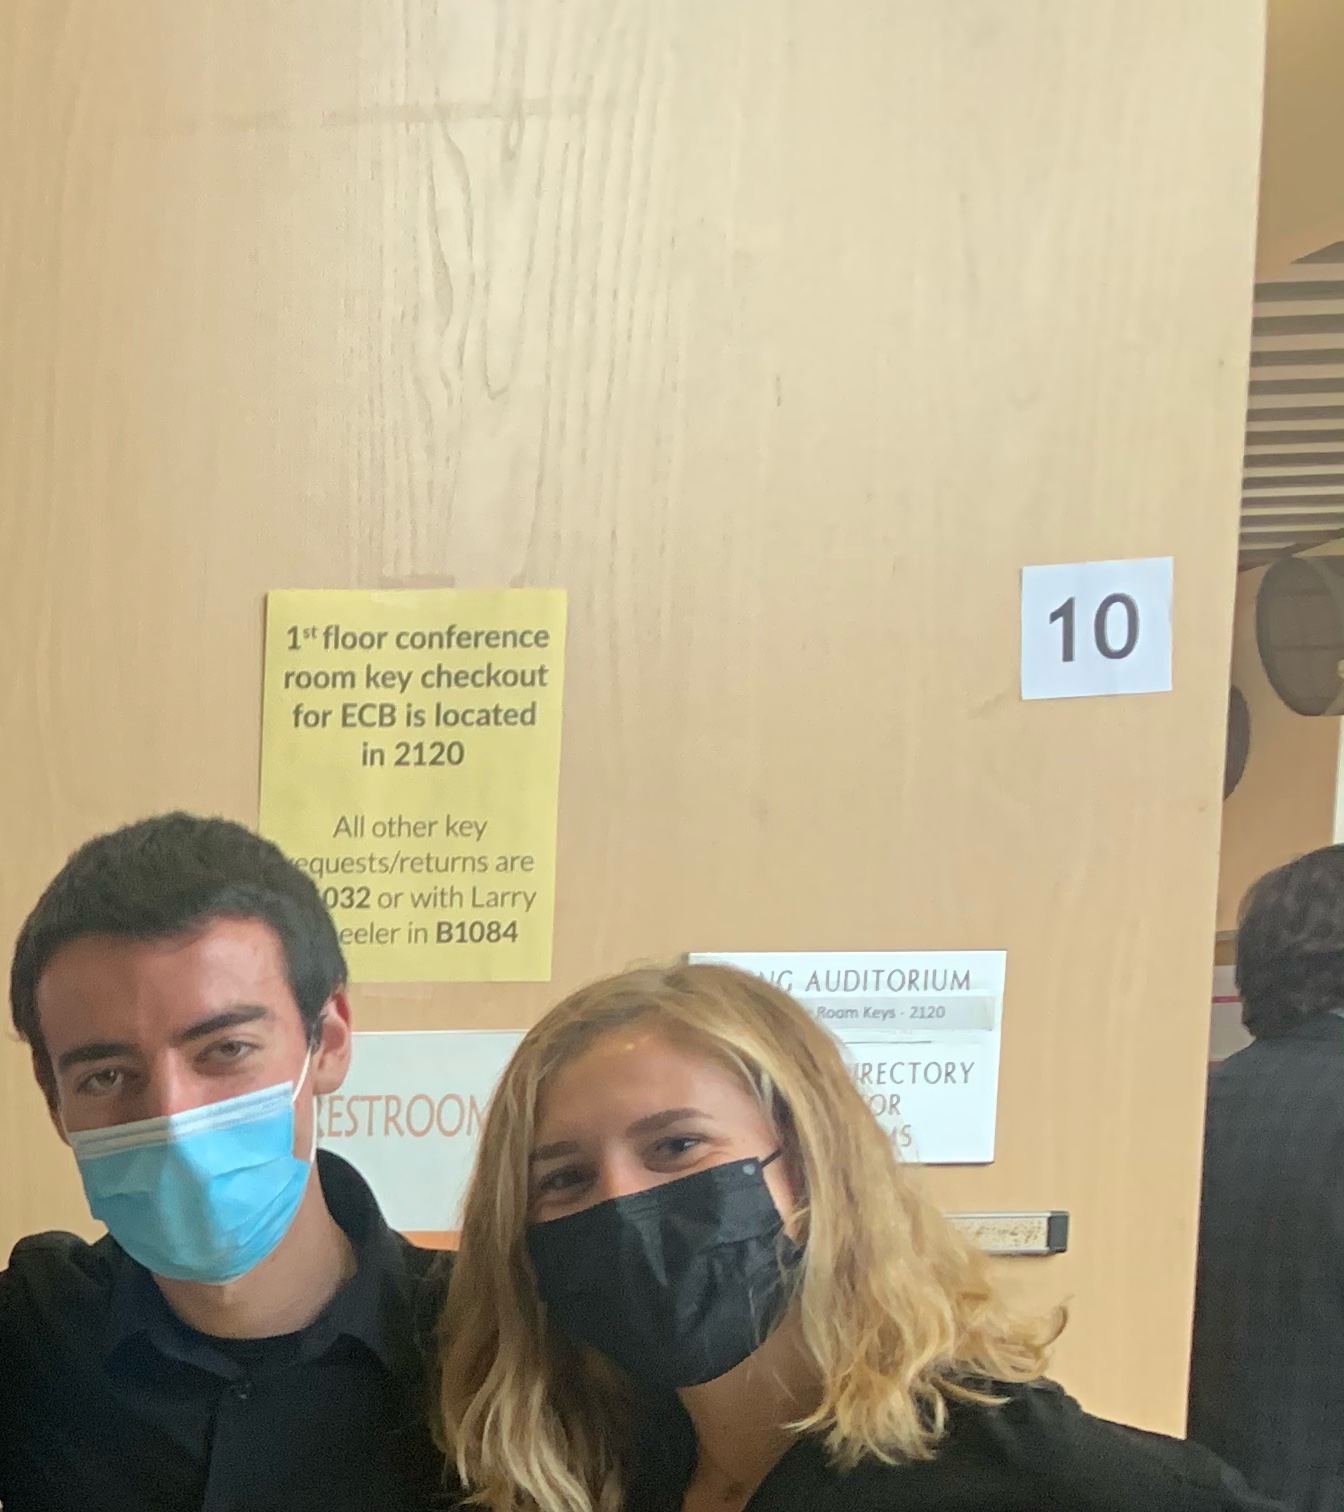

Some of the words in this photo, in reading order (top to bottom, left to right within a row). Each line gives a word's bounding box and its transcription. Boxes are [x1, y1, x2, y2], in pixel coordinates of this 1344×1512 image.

[286, 624, 318, 651] 1st
[322, 624, 388, 651] floor
[395, 623, 551, 650] conference
[1049, 592, 1140, 662] 10
[283, 666, 356, 690] room
[365, 664, 413, 694] key
[420, 662, 549, 689] checkout
[292, 702, 333, 729] for
[341, 703, 397, 729] ECB
[406, 702, 426, 728] is
[435, 701, 537, 728] located
[362, 741, 385, 767] in
[394, 740, 465, 767] 2120
[332, 814, 365, 840] All
[372, 814, 439, 839] other
[445, 814, 489, 842] key
[290, 850, 489, 878] equests/returns
[495, 855, 535, 873] are
[322, 886, 371, 909] 032
[377, 891, 404, 909] or
[410, 885, 462, 909] with
[471, 885, 537, 912] Larry
[339, 921, 402, 945] eeler
[407, 921, 429, 944] in
[436, 920, 520, 944] B1084
[805, 968, 972, 993] AUDITORIUM
[816, 1003, 859, 1020] Room
[863, 1005, 897, 1021] Keys
[909, 1005, 946, 1020] 2120
[853, 1061, 975, 1085] IRECTORY
[317, 1093, 488, 1138] ESTROOM
[864, 1094, 901, 1117] OR
